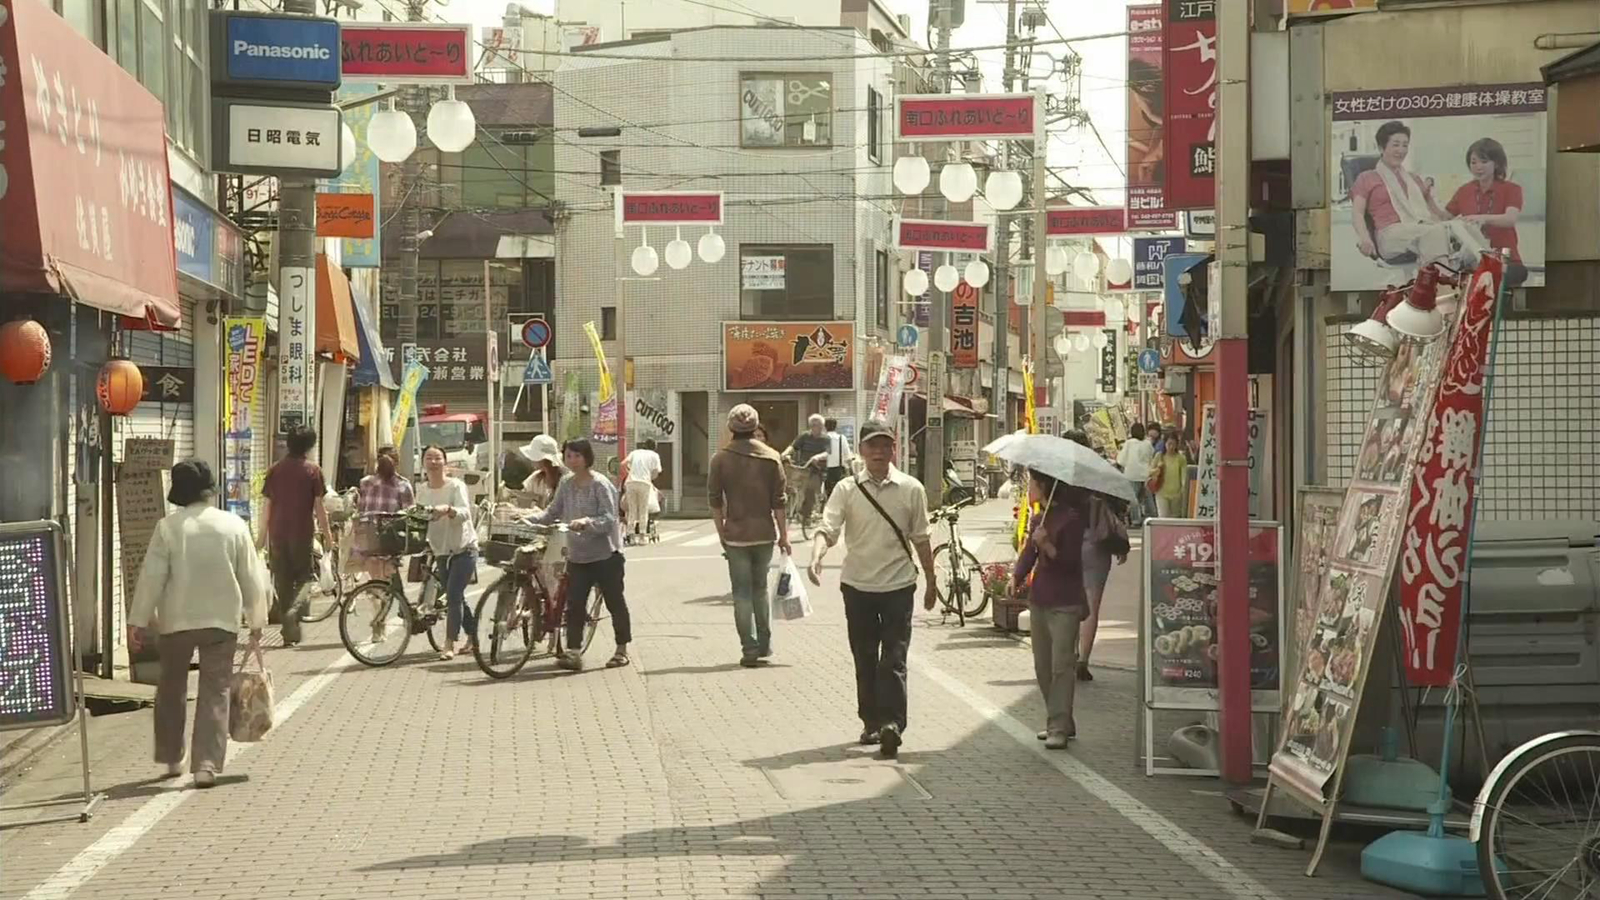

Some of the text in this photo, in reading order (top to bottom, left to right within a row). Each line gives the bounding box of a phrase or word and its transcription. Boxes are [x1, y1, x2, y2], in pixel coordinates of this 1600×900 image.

[234, 40, 330, 61] Panasonic
[1335, 89, 1545, 114] 女性だけの30分健康体操教室
[248, 129, 320, 146] 日昭電気
[289, 273, 304, 384] つしま眼科
[635, 398, 675, 435] CUT1000
